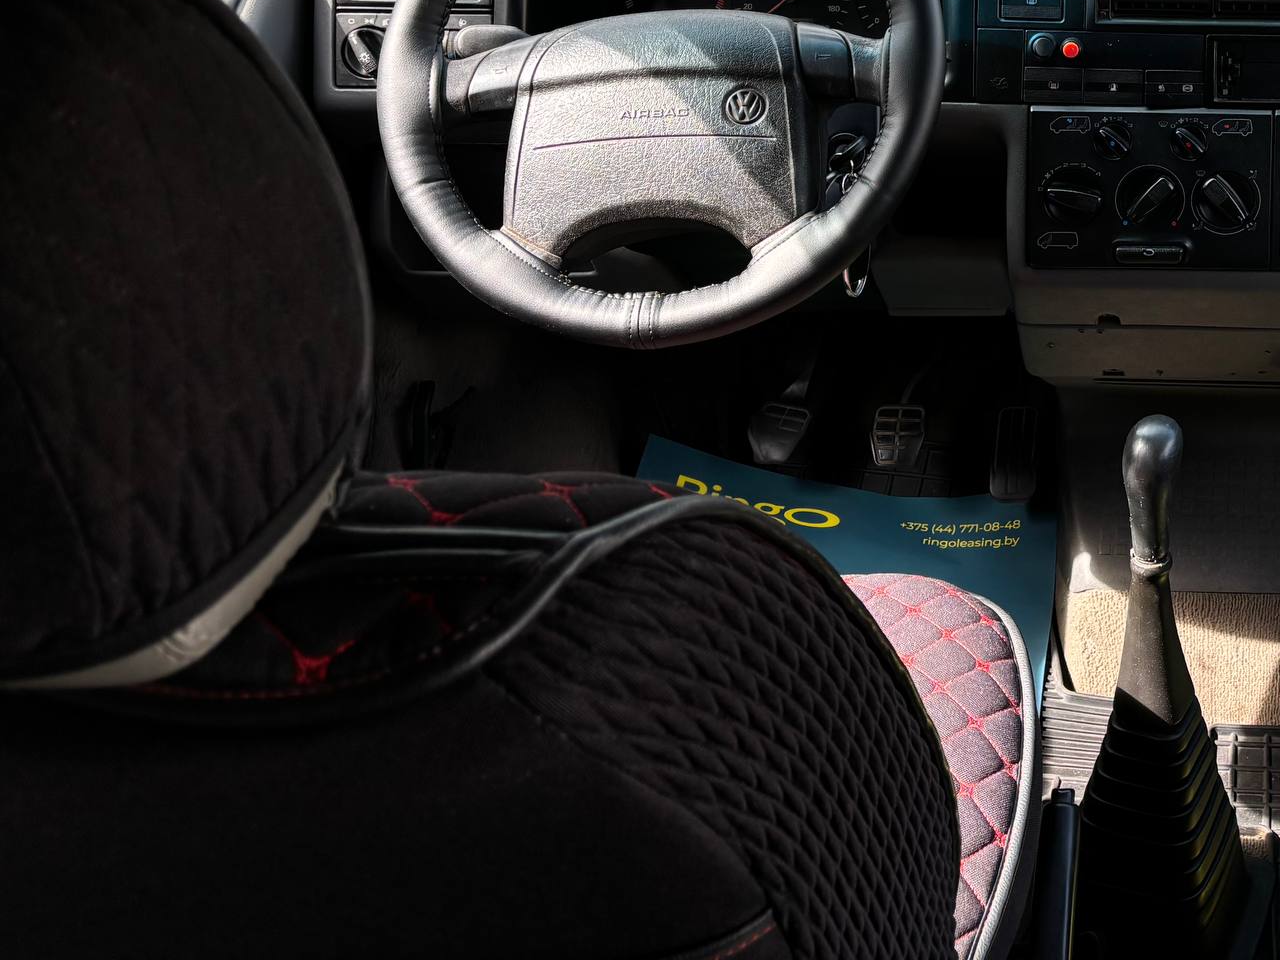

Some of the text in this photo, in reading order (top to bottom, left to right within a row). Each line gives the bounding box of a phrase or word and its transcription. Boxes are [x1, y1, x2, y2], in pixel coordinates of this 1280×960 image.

[620, 108, 690, 120] AIRBAG
[900, 520, 1021, 535] +375 (44) 771-08-48
[922, 536, 1020, 549] ringoleasing.by
